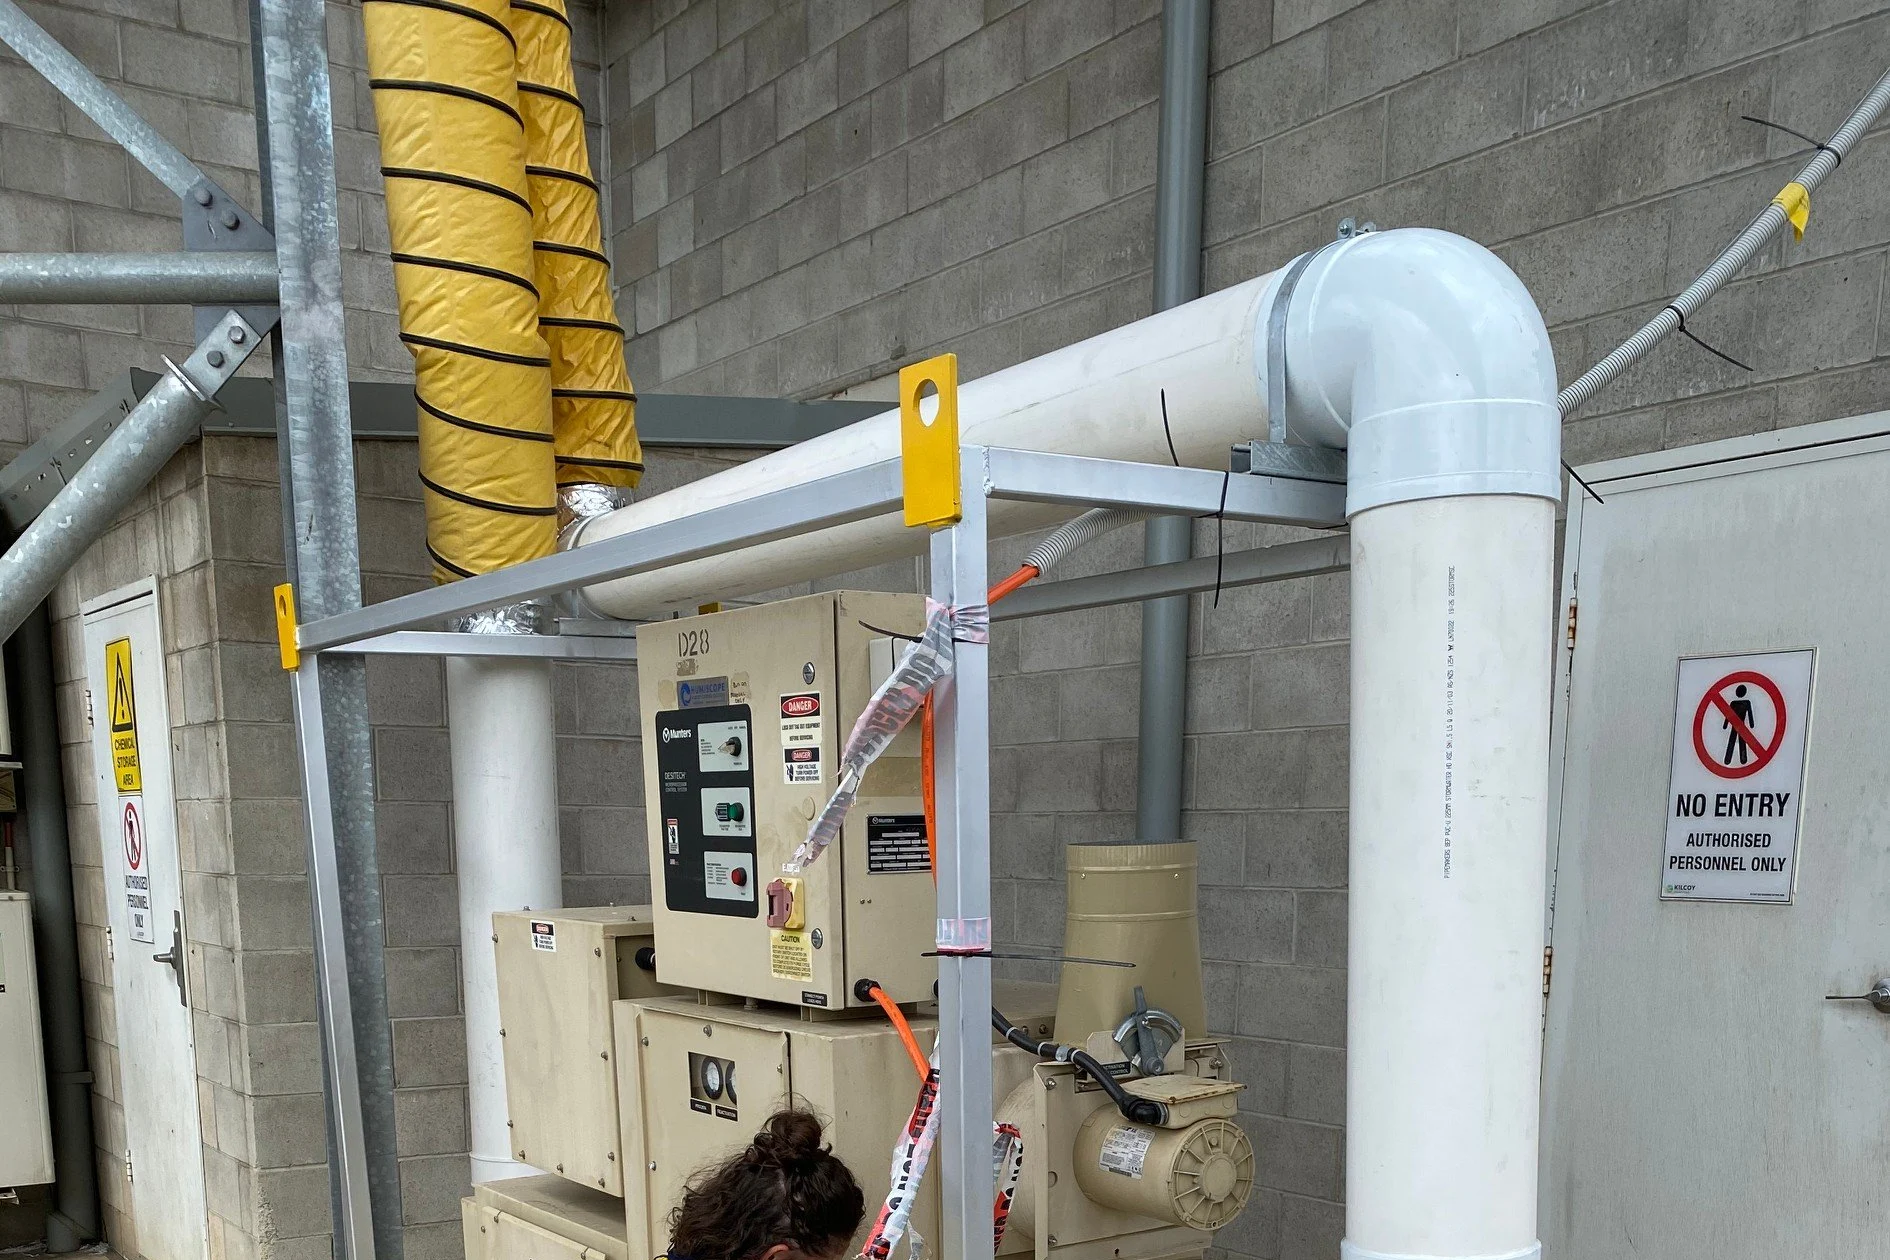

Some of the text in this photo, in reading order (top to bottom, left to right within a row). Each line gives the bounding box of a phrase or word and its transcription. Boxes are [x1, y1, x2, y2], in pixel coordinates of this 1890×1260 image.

[678, 629, 709, 657] D28
[789, 700, 812, 712] DANGER
[670, 729, 691, 738] Munters
[115, 737, 135, 750] CHEMICAL
[117, 755, 136, 768] STORAGE
[123, 774, 134, 785] AREA
[1676, 792, 1790, 817] NO ENTRY
[1686, 833, 1772, 848] AUTHORISED
[1669, 856, 1786, 872] PERSONNEL ONLY
[125, 875, 147, 890] AUTHORISED
[127, 894, 148, 909] PERSONNEL
[781, 935, 800, 943] CAUTION
